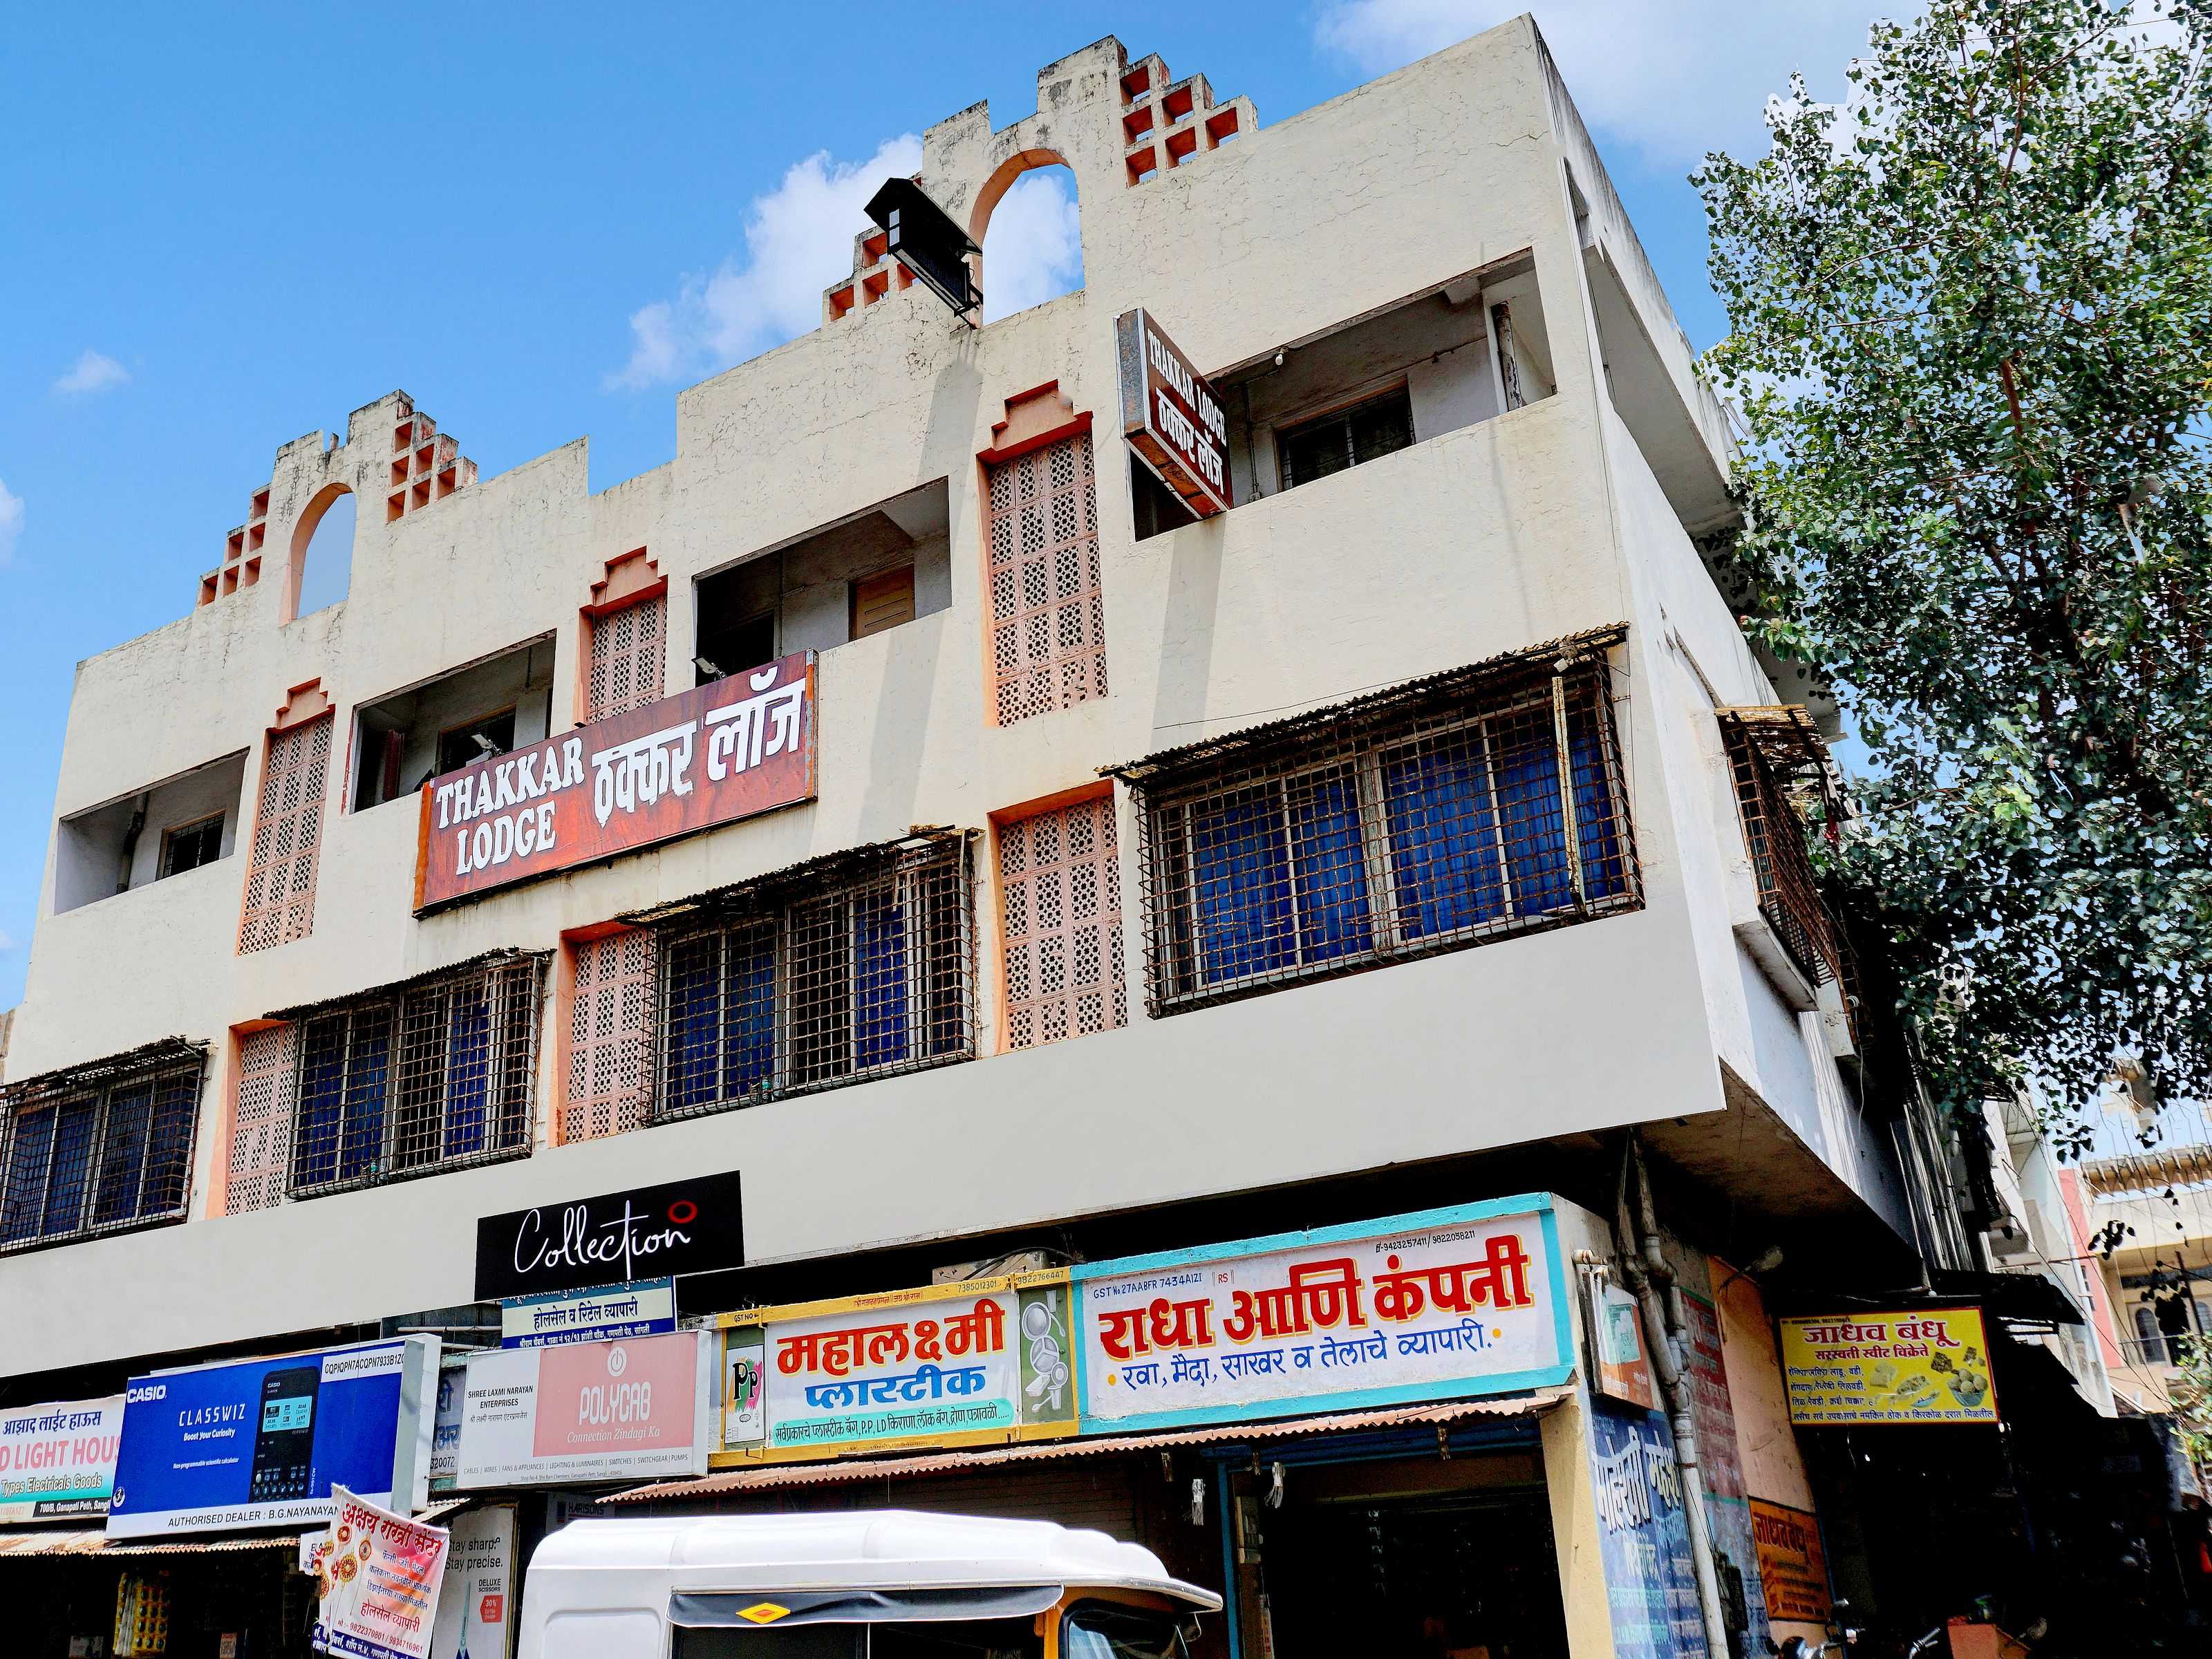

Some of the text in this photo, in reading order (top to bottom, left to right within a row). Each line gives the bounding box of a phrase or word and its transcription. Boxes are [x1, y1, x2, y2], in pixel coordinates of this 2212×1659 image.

[1147, 328, 1227, 447] THAKKAR LODGE
[1195, 429, 1224, 495] लॉज
[591, 666, 806, 829] ठक्कर लॉज
[435, 736, 585, 830] THAKKAR
[456, 800, 556, 876] LODGE
[514, 1200, 694, 1280] Collection
[958, 1281, 997, 1293] 7385012301
[1094, 1286, 1112, 1299] GST
[1098, 1235, 1531, 1360] राधा आणि कंपनी
[534, 1295, 638, 1331] होलसेल व रिटेल व्यापारी
[734, 1314, 744, 1322] GST
[777, 1298, 1006, 1376] महालक्ष्मी
[1802, 1316, 1960, 1347] जाधव बंधू
[1221, 1349, 1286, 1380] साखर
[1291, 1346, 1314, 1369] व
[1320, 1329, 1387, 1367] तेलाचे
[1863, 1344, 1891, 1359] स्वीट
[1893, 1344, 1929, 1358] विक्रेते
[127, 1385, 166, 1403] CASIO
[468, 1385, 533, 1398] SHREE LAXMI NARAYAN
[805, 1364, 986, 1409] प्लास्टीक
[179, 1403, 245, 1427] CLASSWIZ
[480, 1398, 518, 1409] ENTERPRISES
[579, 1382, 651, 1426] POLYCAB
[3, 1409, 102, 1435] आझाद लाईट हाऊस
[184, 1427, 235, 1441] Boost Your Curiosity
[567, 1426, 660, 1443] Connection Zindagi Ka
[14, 1441, 69, 1470] LIGHT
[576, 1459, 603, 1468] LUMINAIRES
[609, 1457, 632, 1465] SWITCHES
[637, 1455, 668, 1464] SWITCHGEAR
[1, 1472, 102, 1498] Types Electricals Goods
[168, 1514, 223, 1527] AUTHORISED
[226, 1511, 261, 1522] DEALER
[343, 1503, 442, 1560] अक्षय राखी सेंटर
[467, 1555, 503, 1572] precise.
[478, 1578, 501, 1586] DELUXE
[361, 1598, 420, 1633] होलसेल व्यापारी
